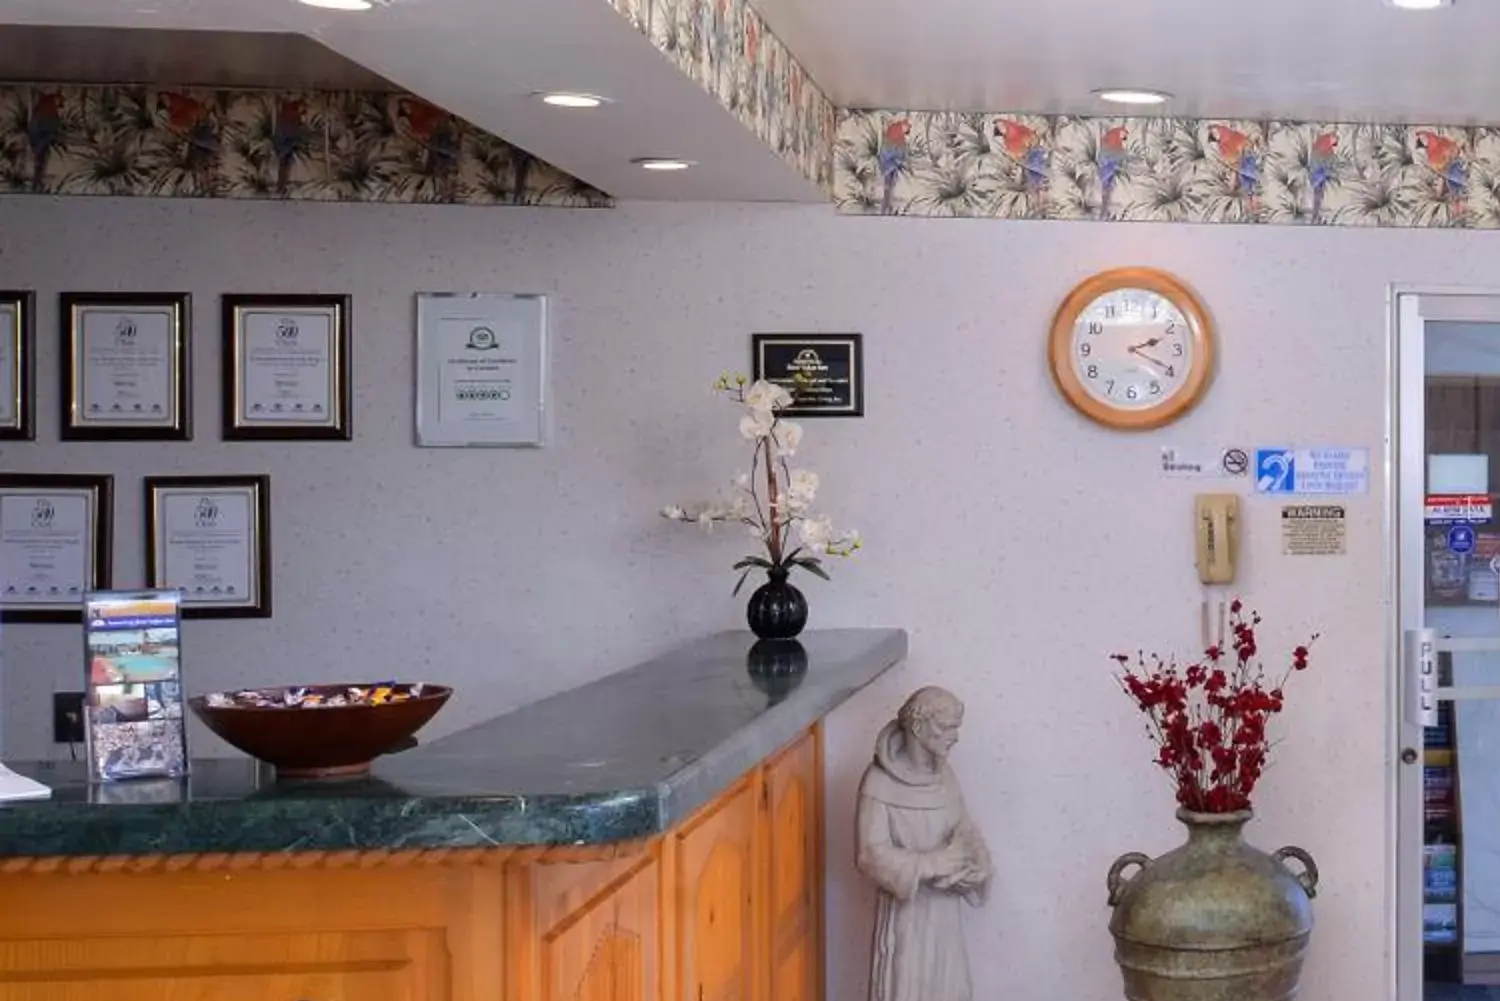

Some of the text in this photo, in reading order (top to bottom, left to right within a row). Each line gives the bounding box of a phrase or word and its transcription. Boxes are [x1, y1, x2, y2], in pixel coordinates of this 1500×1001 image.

[1105, 305, 1116, 318] 11
[1124, 299, 1138, 312] 12
[1152, 306, 1158, 318] 1
[1088, 322, 1103, 335] 10
[1165, 320, 1175, 334] 2
[1080, 343, 1091, 357] 9
[1172, 343, 1183, 357] 3
[1087, 365, 1098, 378] 8
[1165, 366, 1175, 378] 4
[1105, 380, 1115, 394] 7
[1126, 386, 1137, 400] 6
[1150, 381, 1160, 394] 5
[1287, 506, 1342, 519] WARNING
[1420, 641, 1433, 711] PULL
